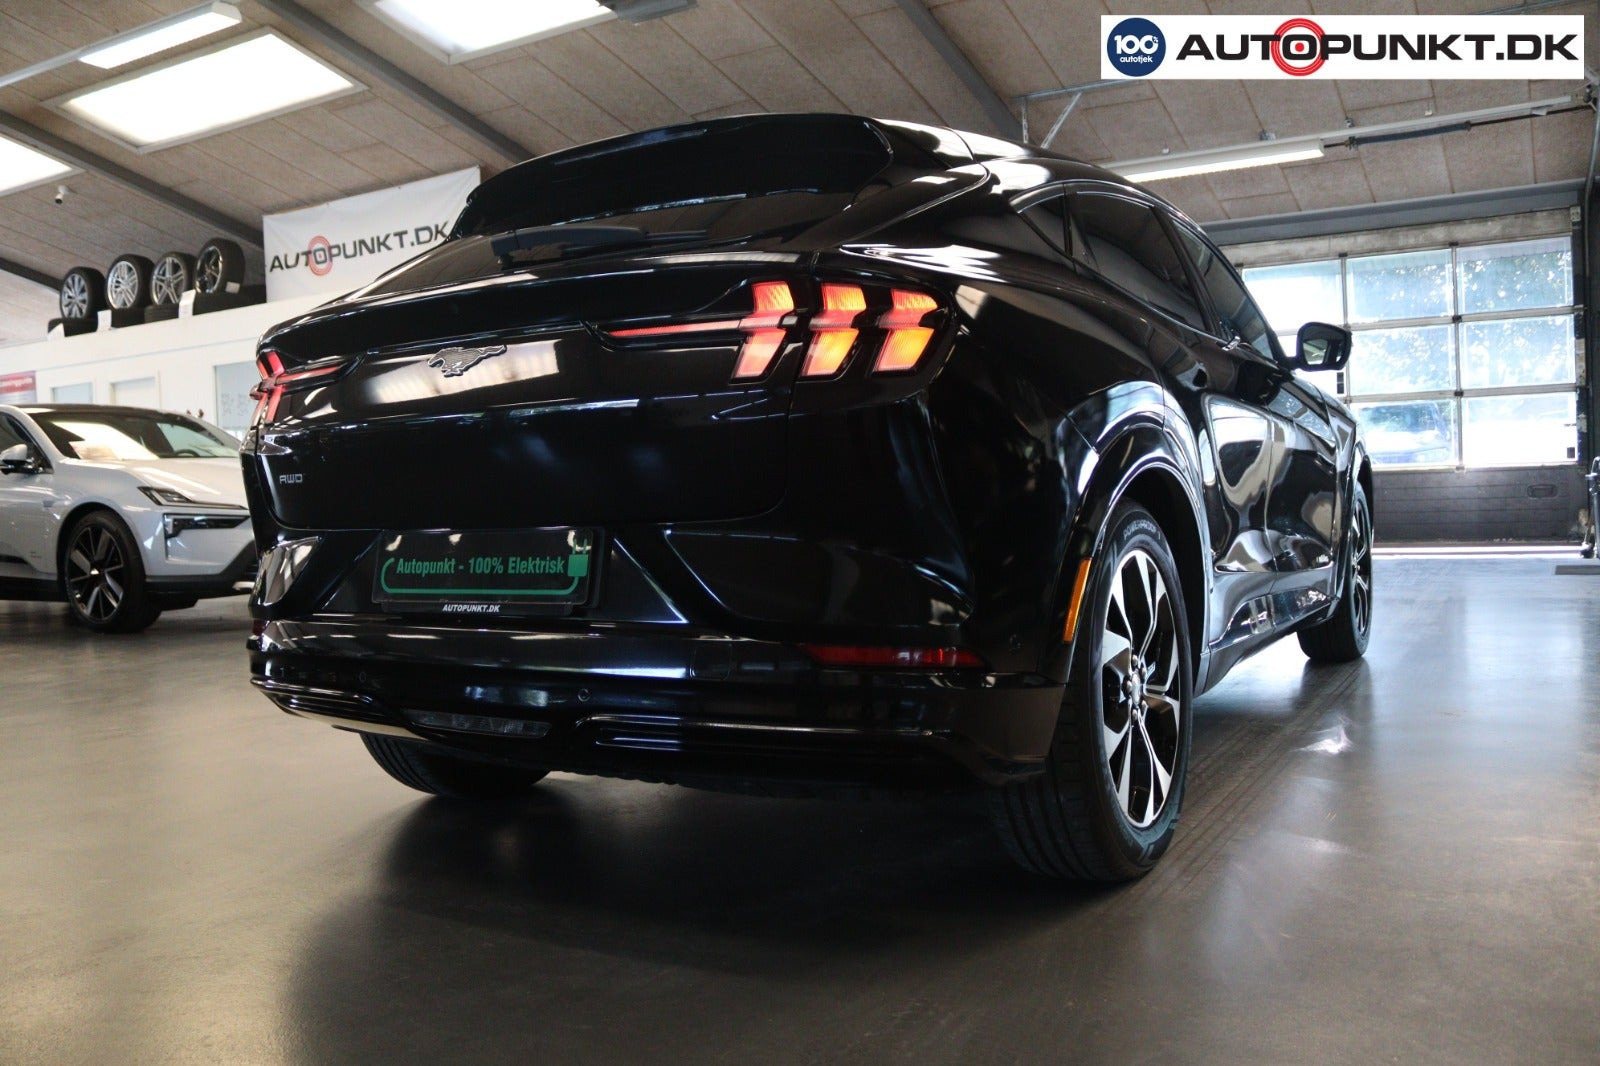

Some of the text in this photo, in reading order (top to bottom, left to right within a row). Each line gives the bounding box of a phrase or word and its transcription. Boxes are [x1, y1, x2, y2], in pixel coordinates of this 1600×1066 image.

[269, 221, 449, 272] AUTOPUNKT.DK
[279, 474, 303, 484] AWD
[396, 557, 456, 577] Autopunkt
[468, 557, 504, 574] 100%
[507, 555, 565, 575] Elektrisk
[442, 604, 501, 613] AUTOPUNKT.DK
